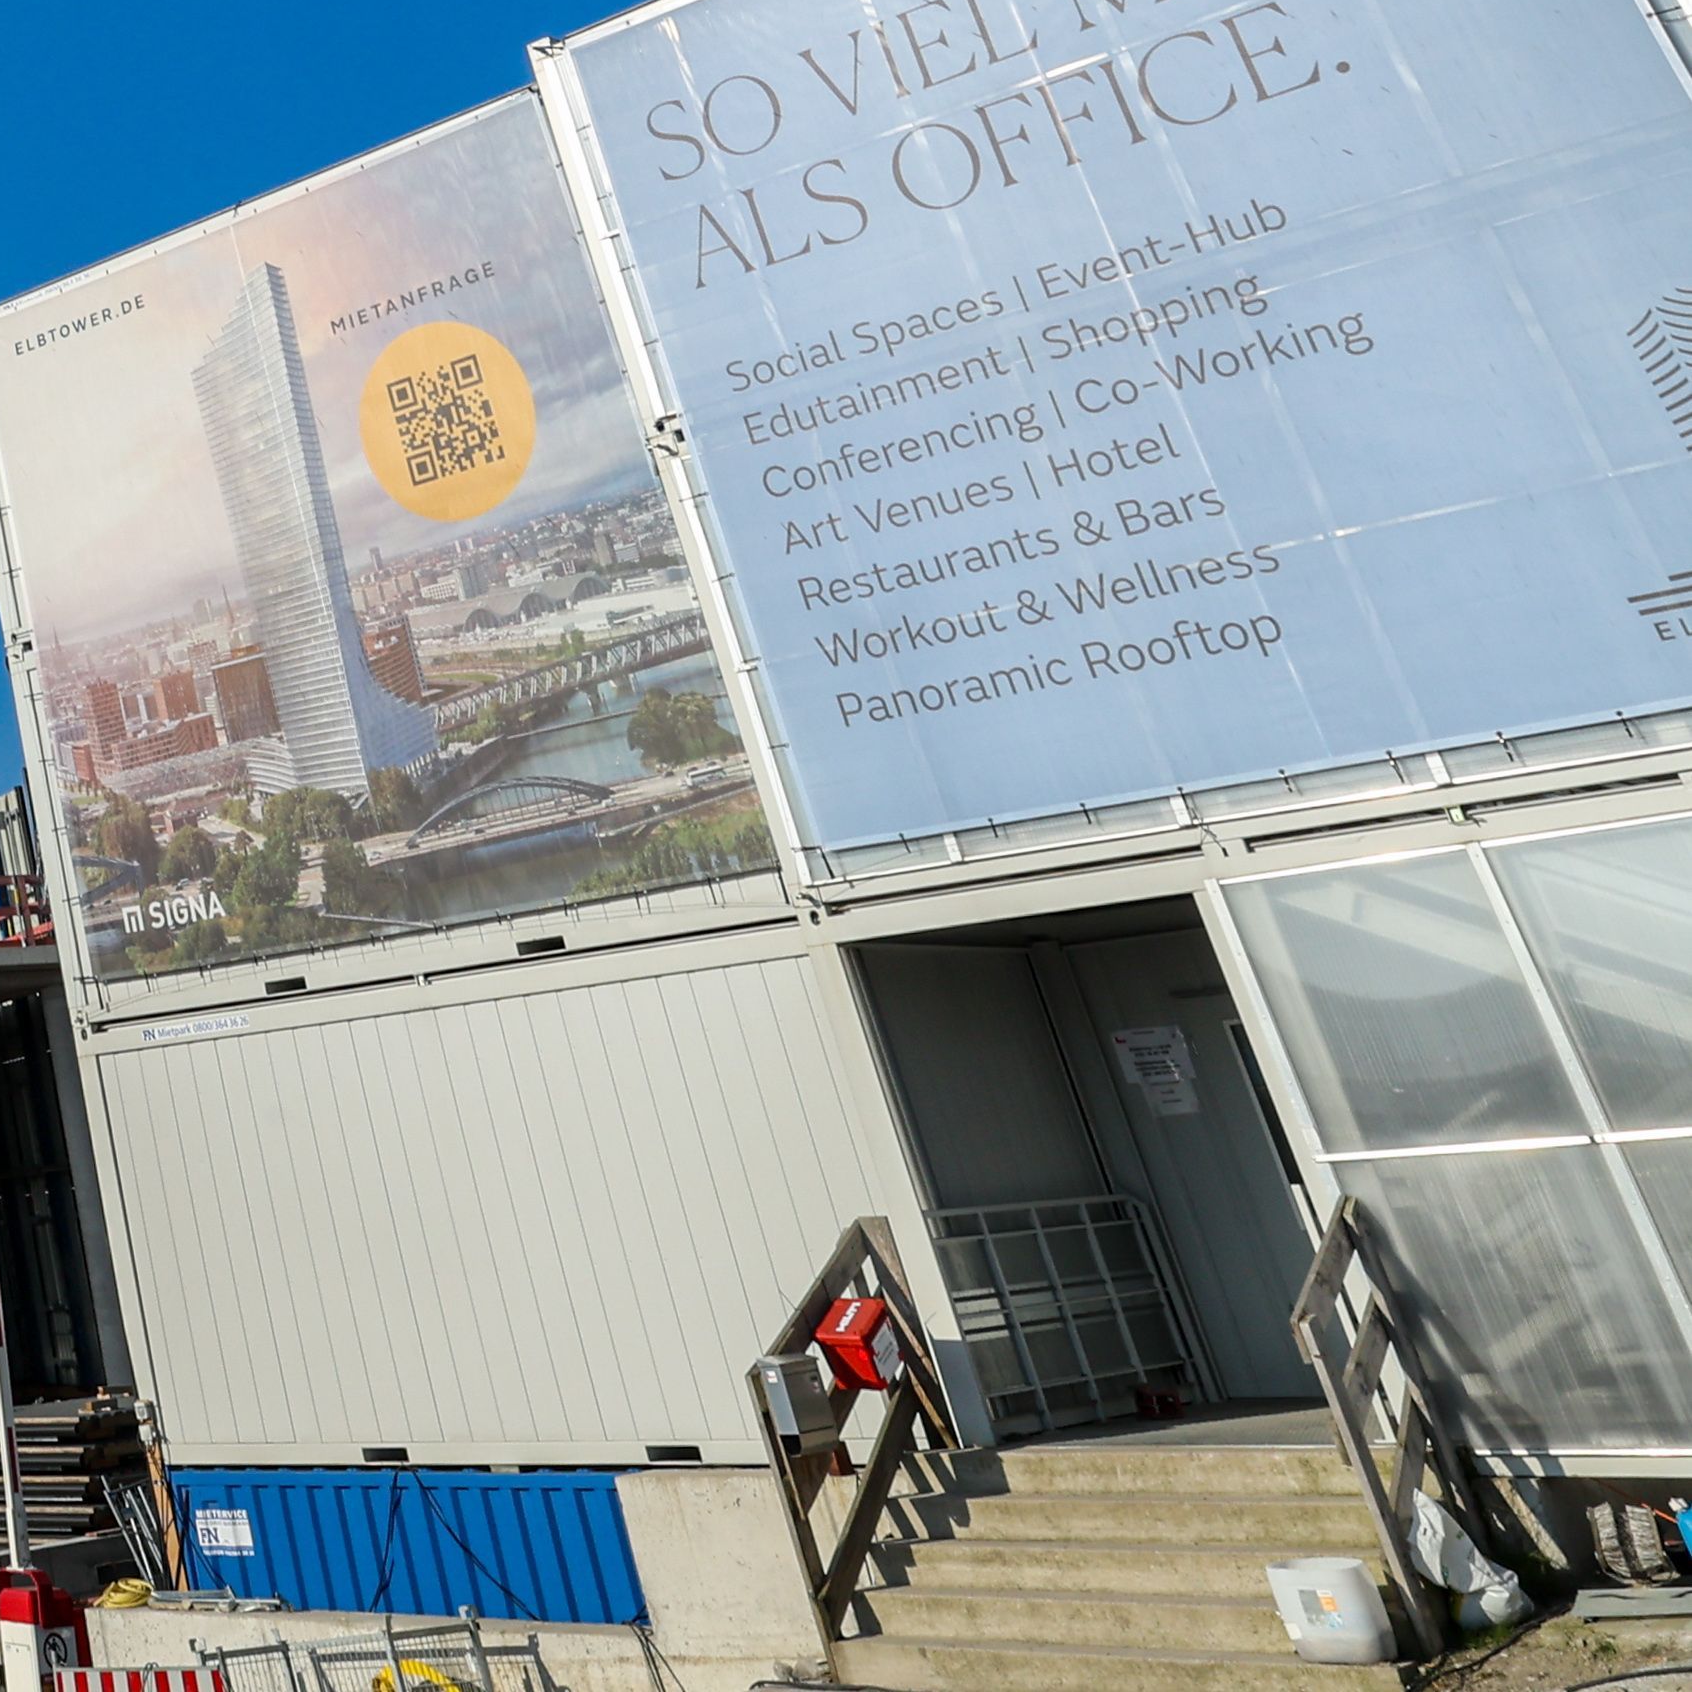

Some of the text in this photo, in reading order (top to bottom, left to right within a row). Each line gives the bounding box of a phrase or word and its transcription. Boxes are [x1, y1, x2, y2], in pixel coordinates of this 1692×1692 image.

[647, 75, 782, 180] SO
[696, 2, 1350, 289] ALS OFFICE.
[14, 294, 146, 355] ELBTOWER.DE
[330, 260, 496, 335] MIETANFRAGE
[726, 330, 846, 391] Social
[852, 291, 1003, 357] Spaces
[1036, 199, 1286, 299] Event-Hub
[743, 347, 1010, 445] Edutainment
[1042, 275, 1268, 359] Shopping
[763, 403, 1043, 497] Conferencing
[1075, 313, 1374, 413] Co-Working
[781, 513, 849, 555] Art
[853, 476, 1013, 533] Venues
[1047, 423, 1181, 487] Hotel
[798, 489, 1225, 610] Restaurants & Bars
[814, 545, 1279, 667] Workout & Wellness
[836, 615, 1281, 727] Panoramic Rooftop
[148, 891, 226, 929] SIGNA
[157, 1024, 191, 1037] Mietpark
[200, 1527, 220, 1544] FN
